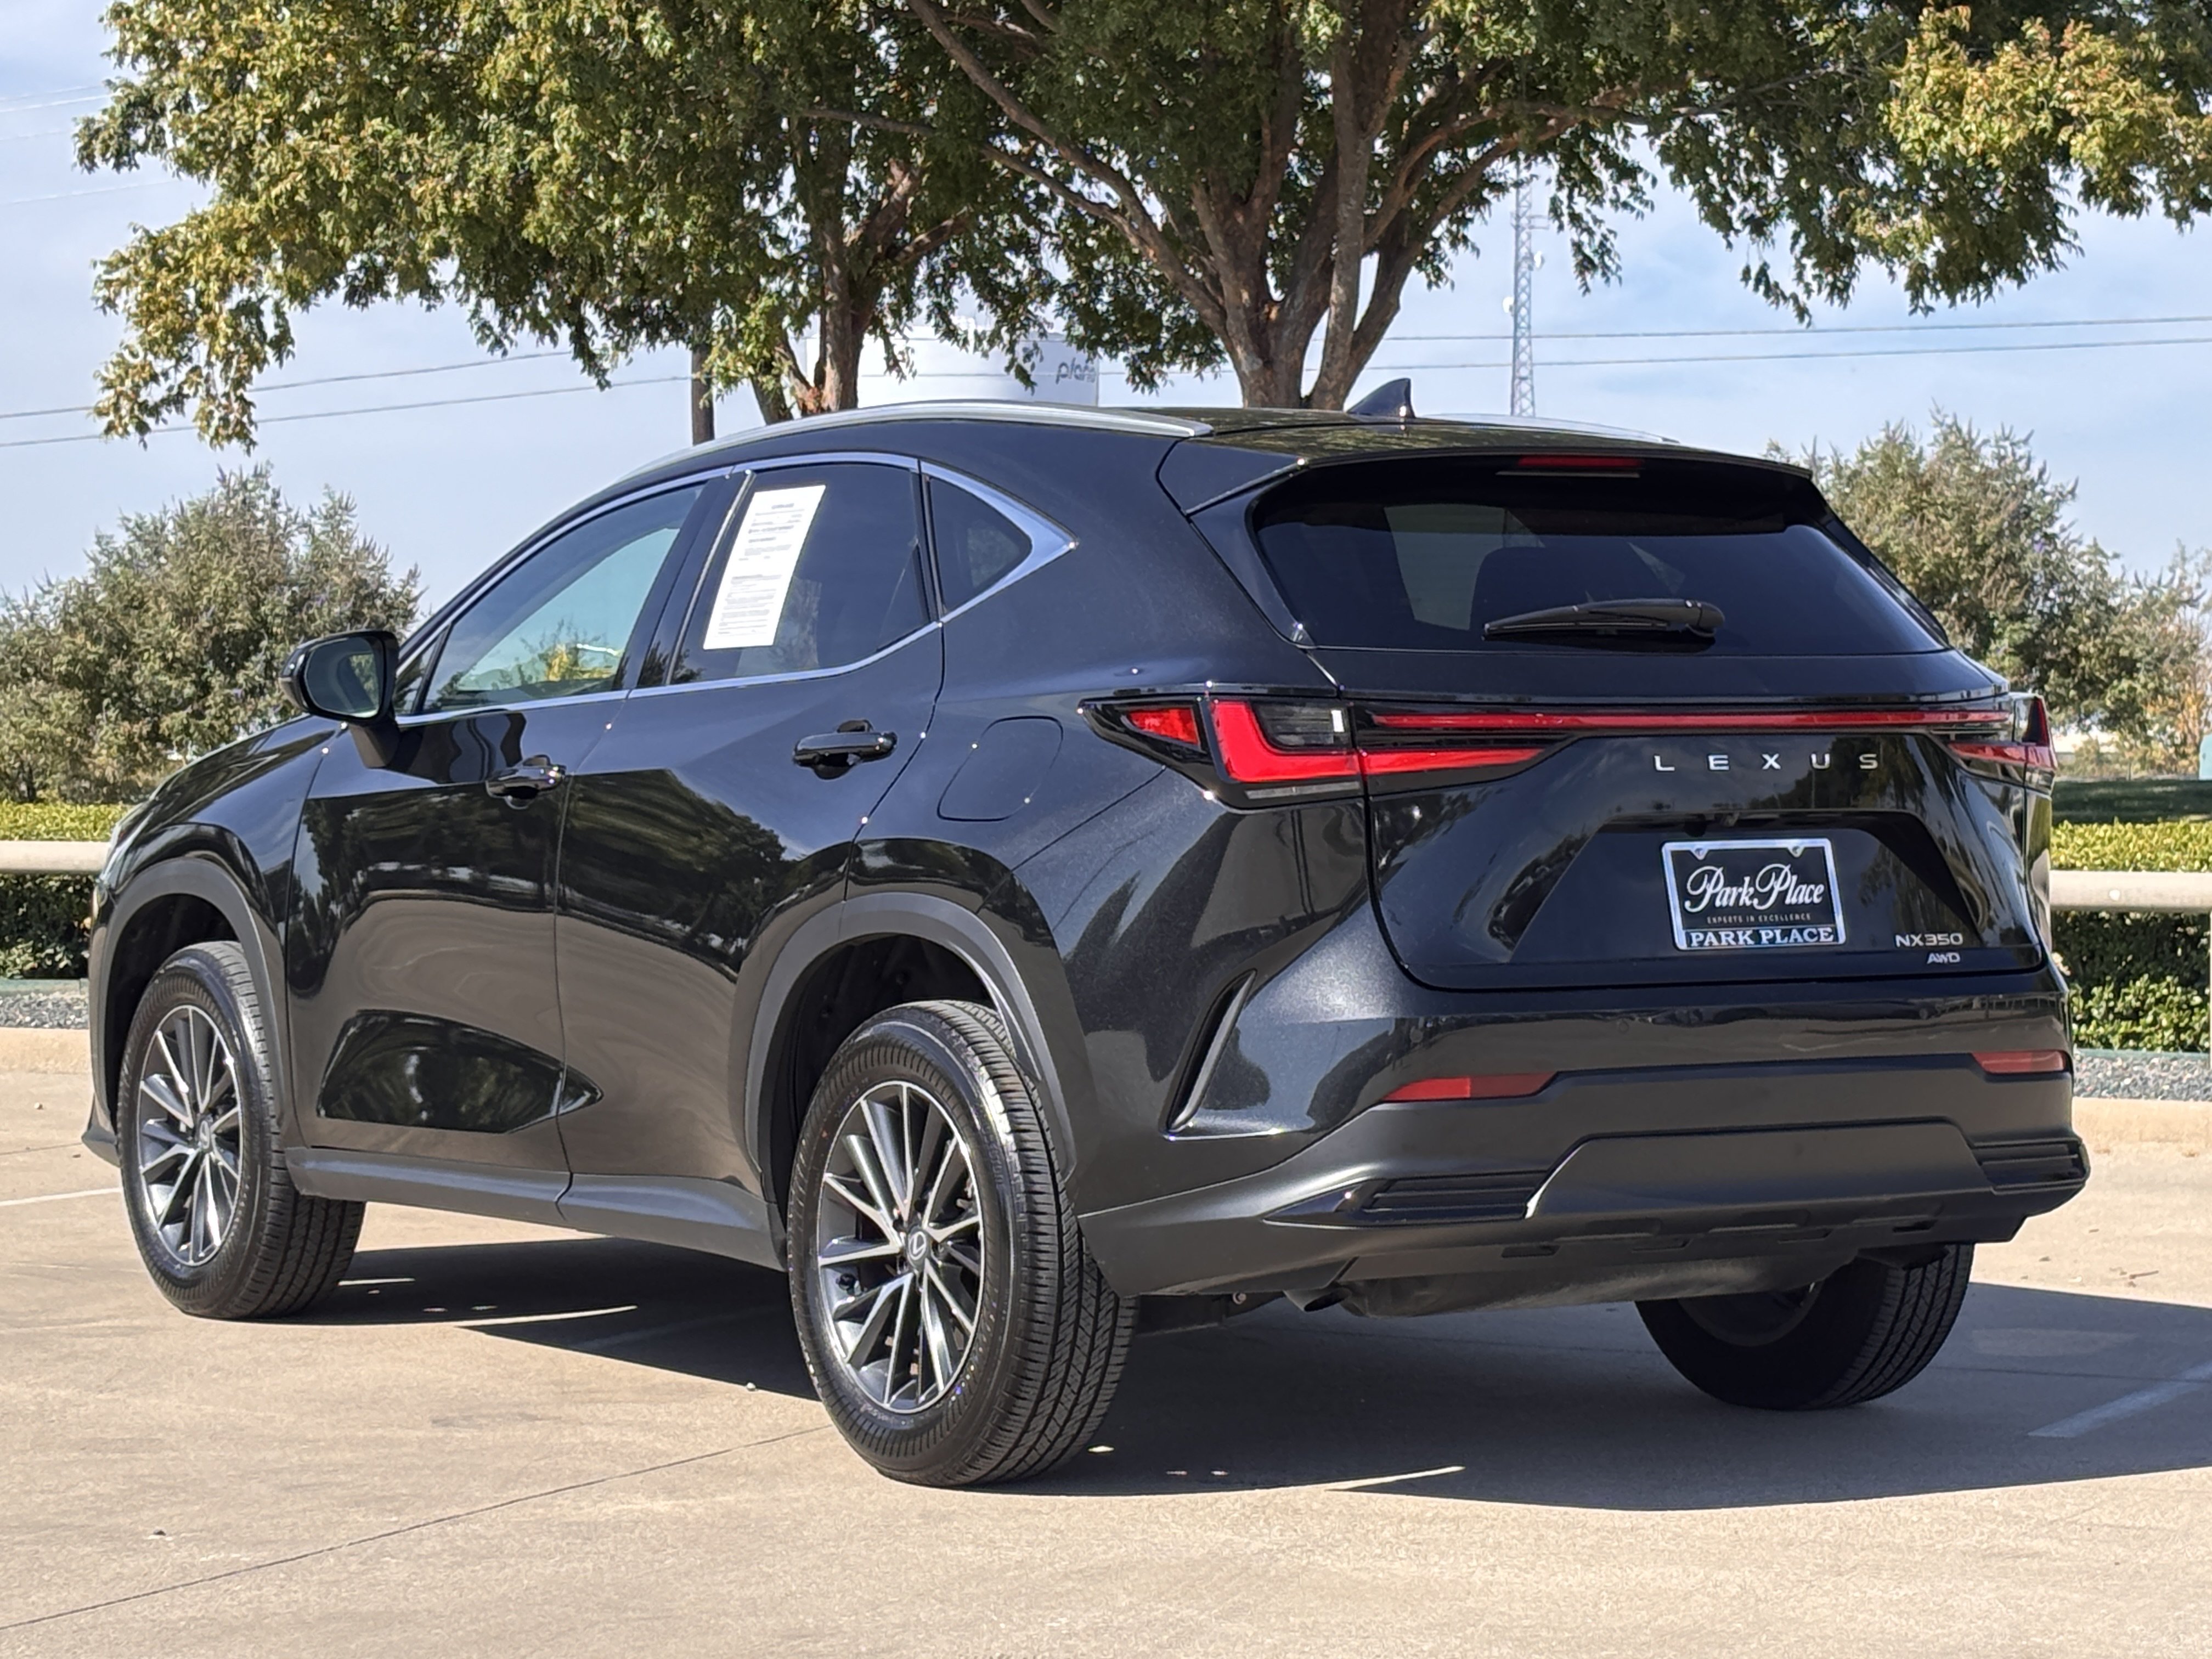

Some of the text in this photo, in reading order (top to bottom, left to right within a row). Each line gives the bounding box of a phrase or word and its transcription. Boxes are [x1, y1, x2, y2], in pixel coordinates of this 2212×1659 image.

[1654, 753, 1878, 771] LEXUS
[1684, 864, 1825, 912] Park Place
[1690, 928, 1834, 947] PARK PLACE
[1895, 933, 1963, 947] NX350
[1927, 952, 1961, 964] AWD
